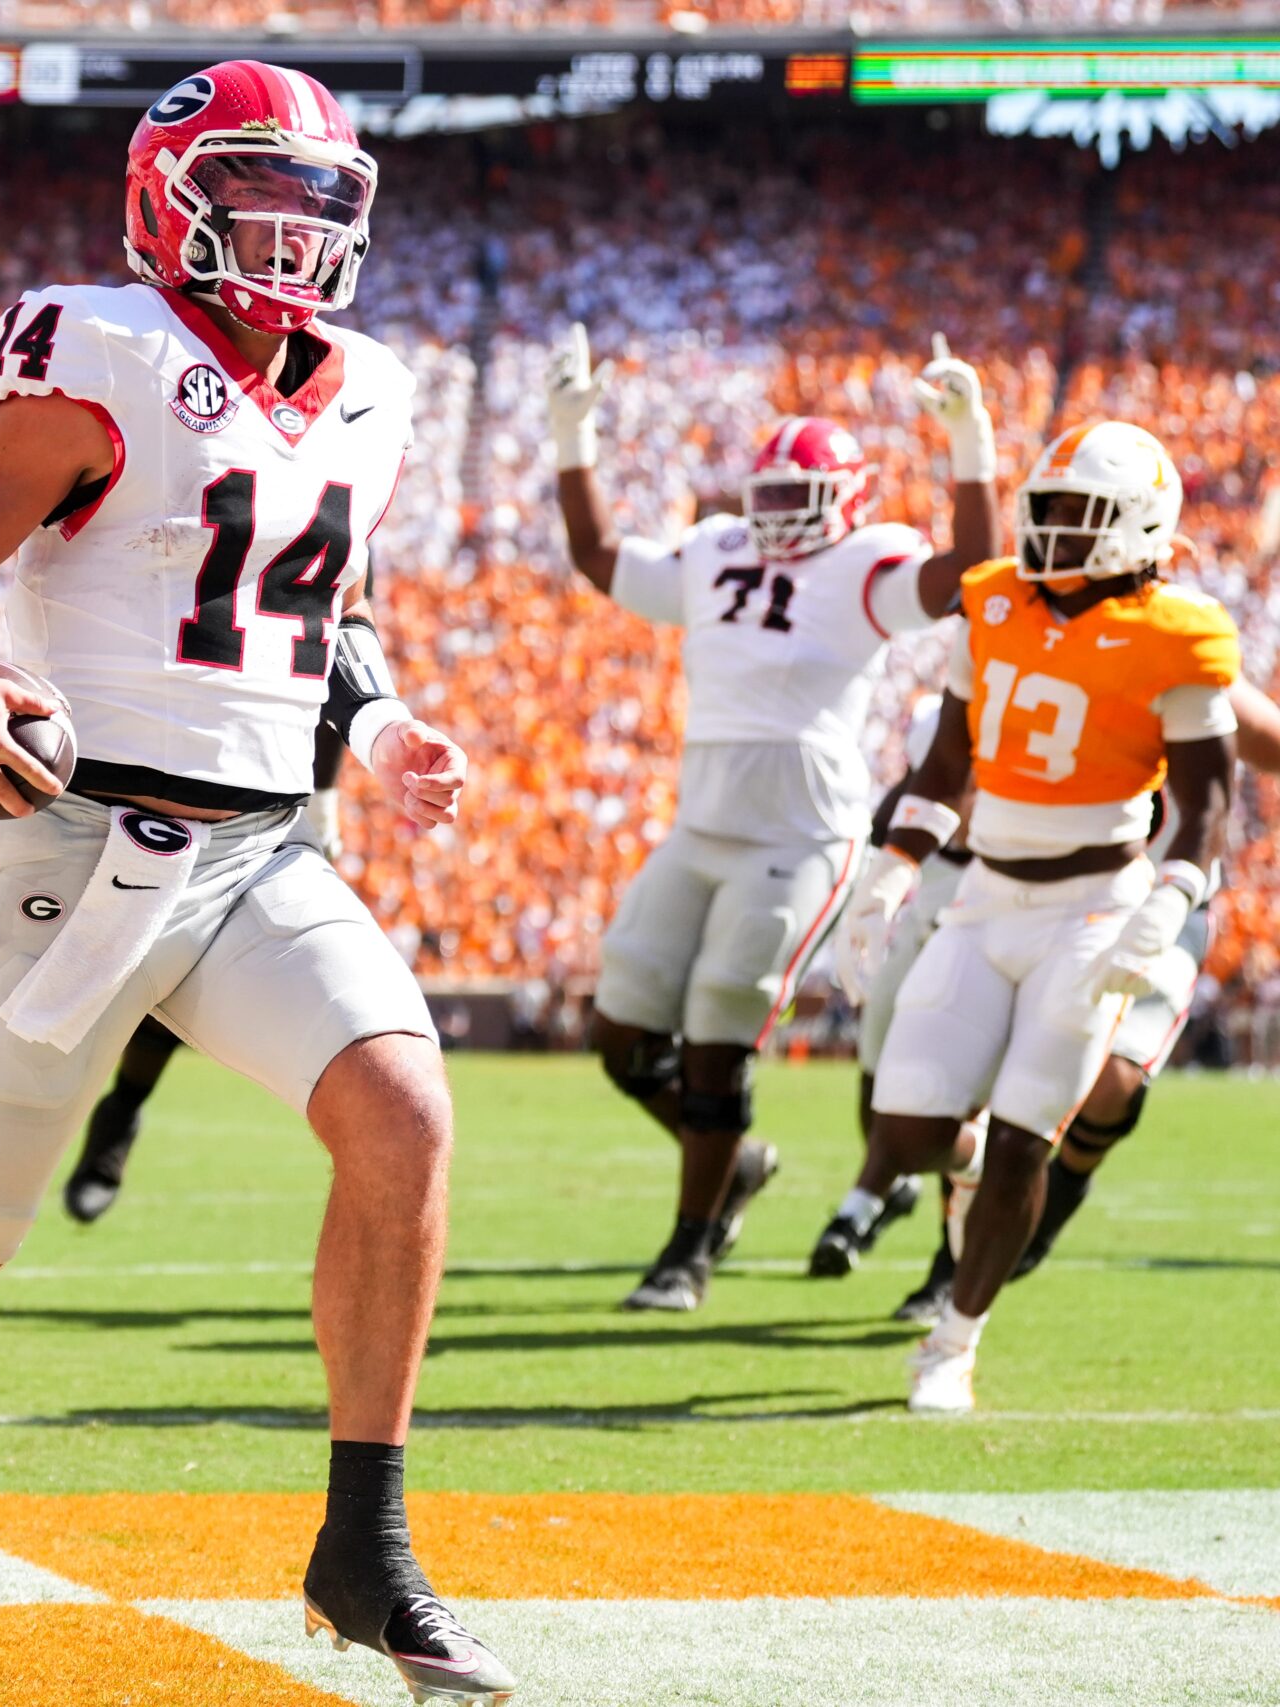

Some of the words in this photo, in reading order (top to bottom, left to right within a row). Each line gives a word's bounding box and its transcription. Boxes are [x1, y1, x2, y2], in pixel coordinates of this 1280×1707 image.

[182, 365, 224, 417] SEC
[177, 408, 232, 432] GRADUATE
[176, 467, 353, 681] 14
[712, 565, 795, 634] 71
[977, 657, 1090, 785] 13
[120, 812, 191, 855] G
[20, 894, 64, 922] G
